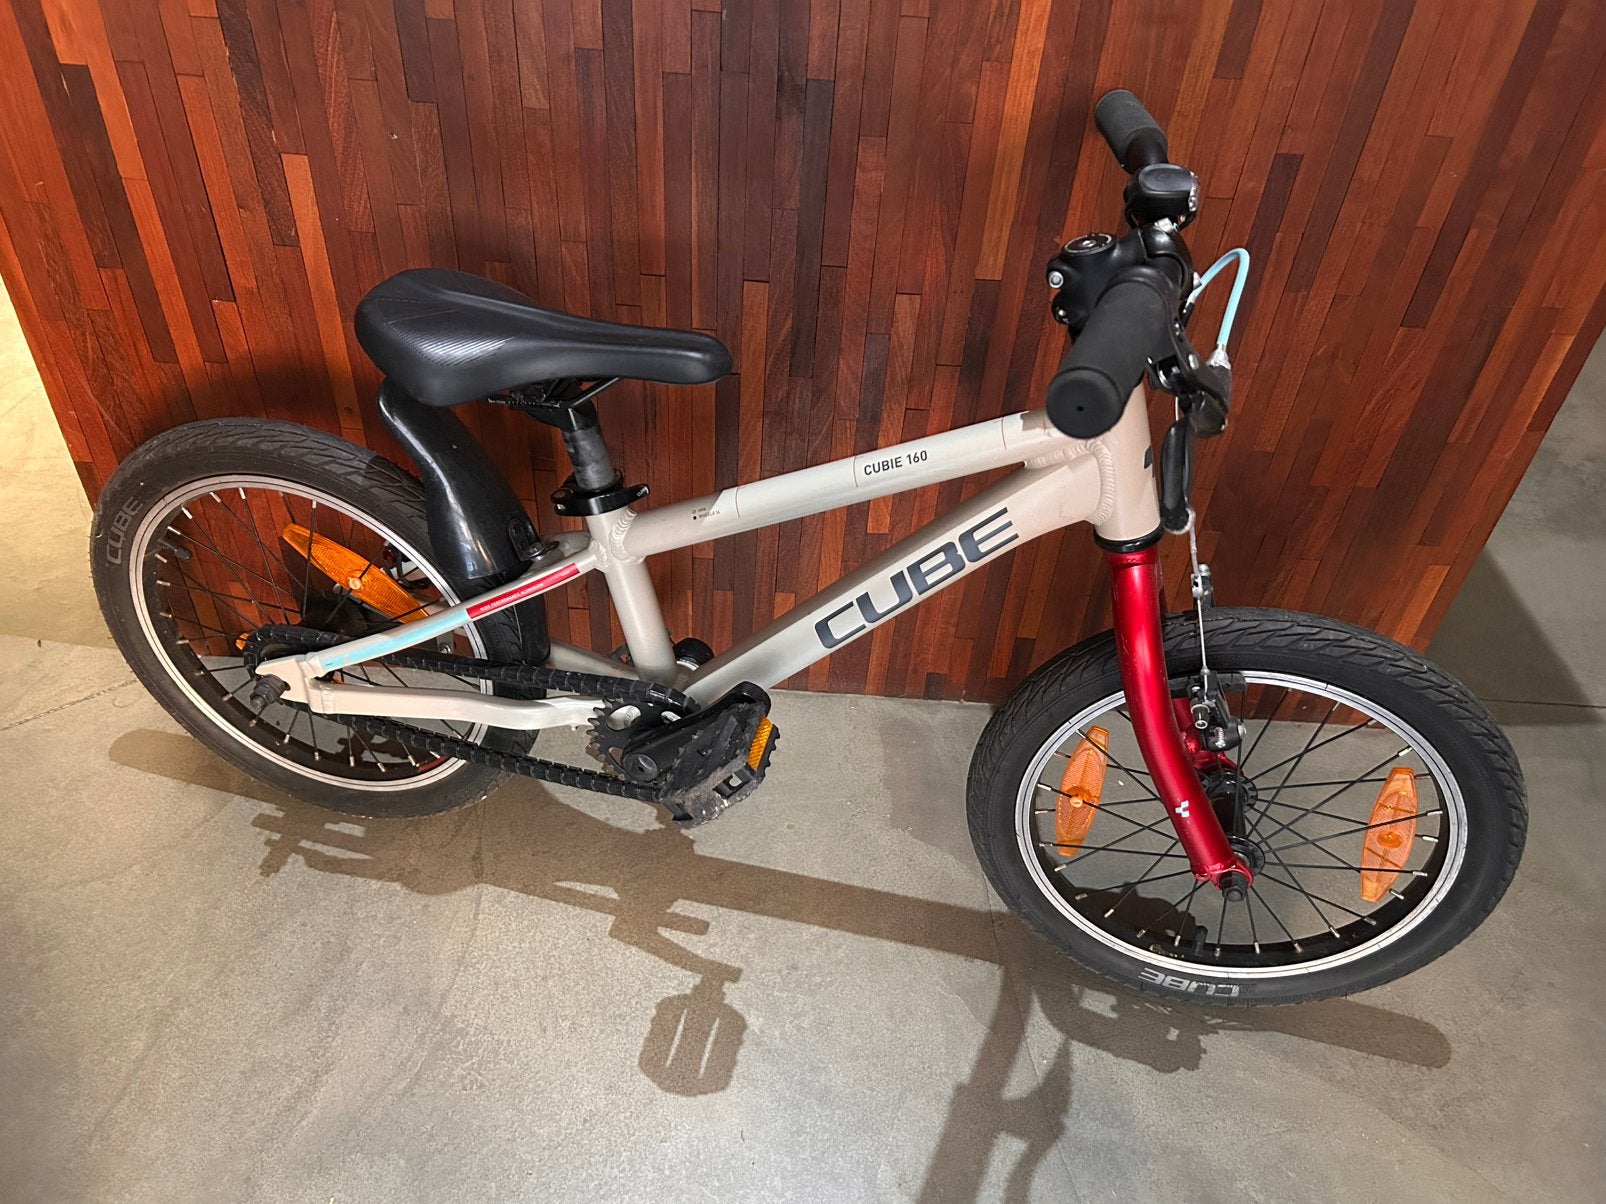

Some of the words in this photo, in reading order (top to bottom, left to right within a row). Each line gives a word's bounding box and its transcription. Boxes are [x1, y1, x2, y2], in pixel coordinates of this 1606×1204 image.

[864, 456, 903, 476] CUBIE
[906, 450, 928, 465] 160
[106, 496, 143, 564] CUBE
[814, 506, 1019, 649] CUBE
[1138, 967, 1240, 997] CUBE
